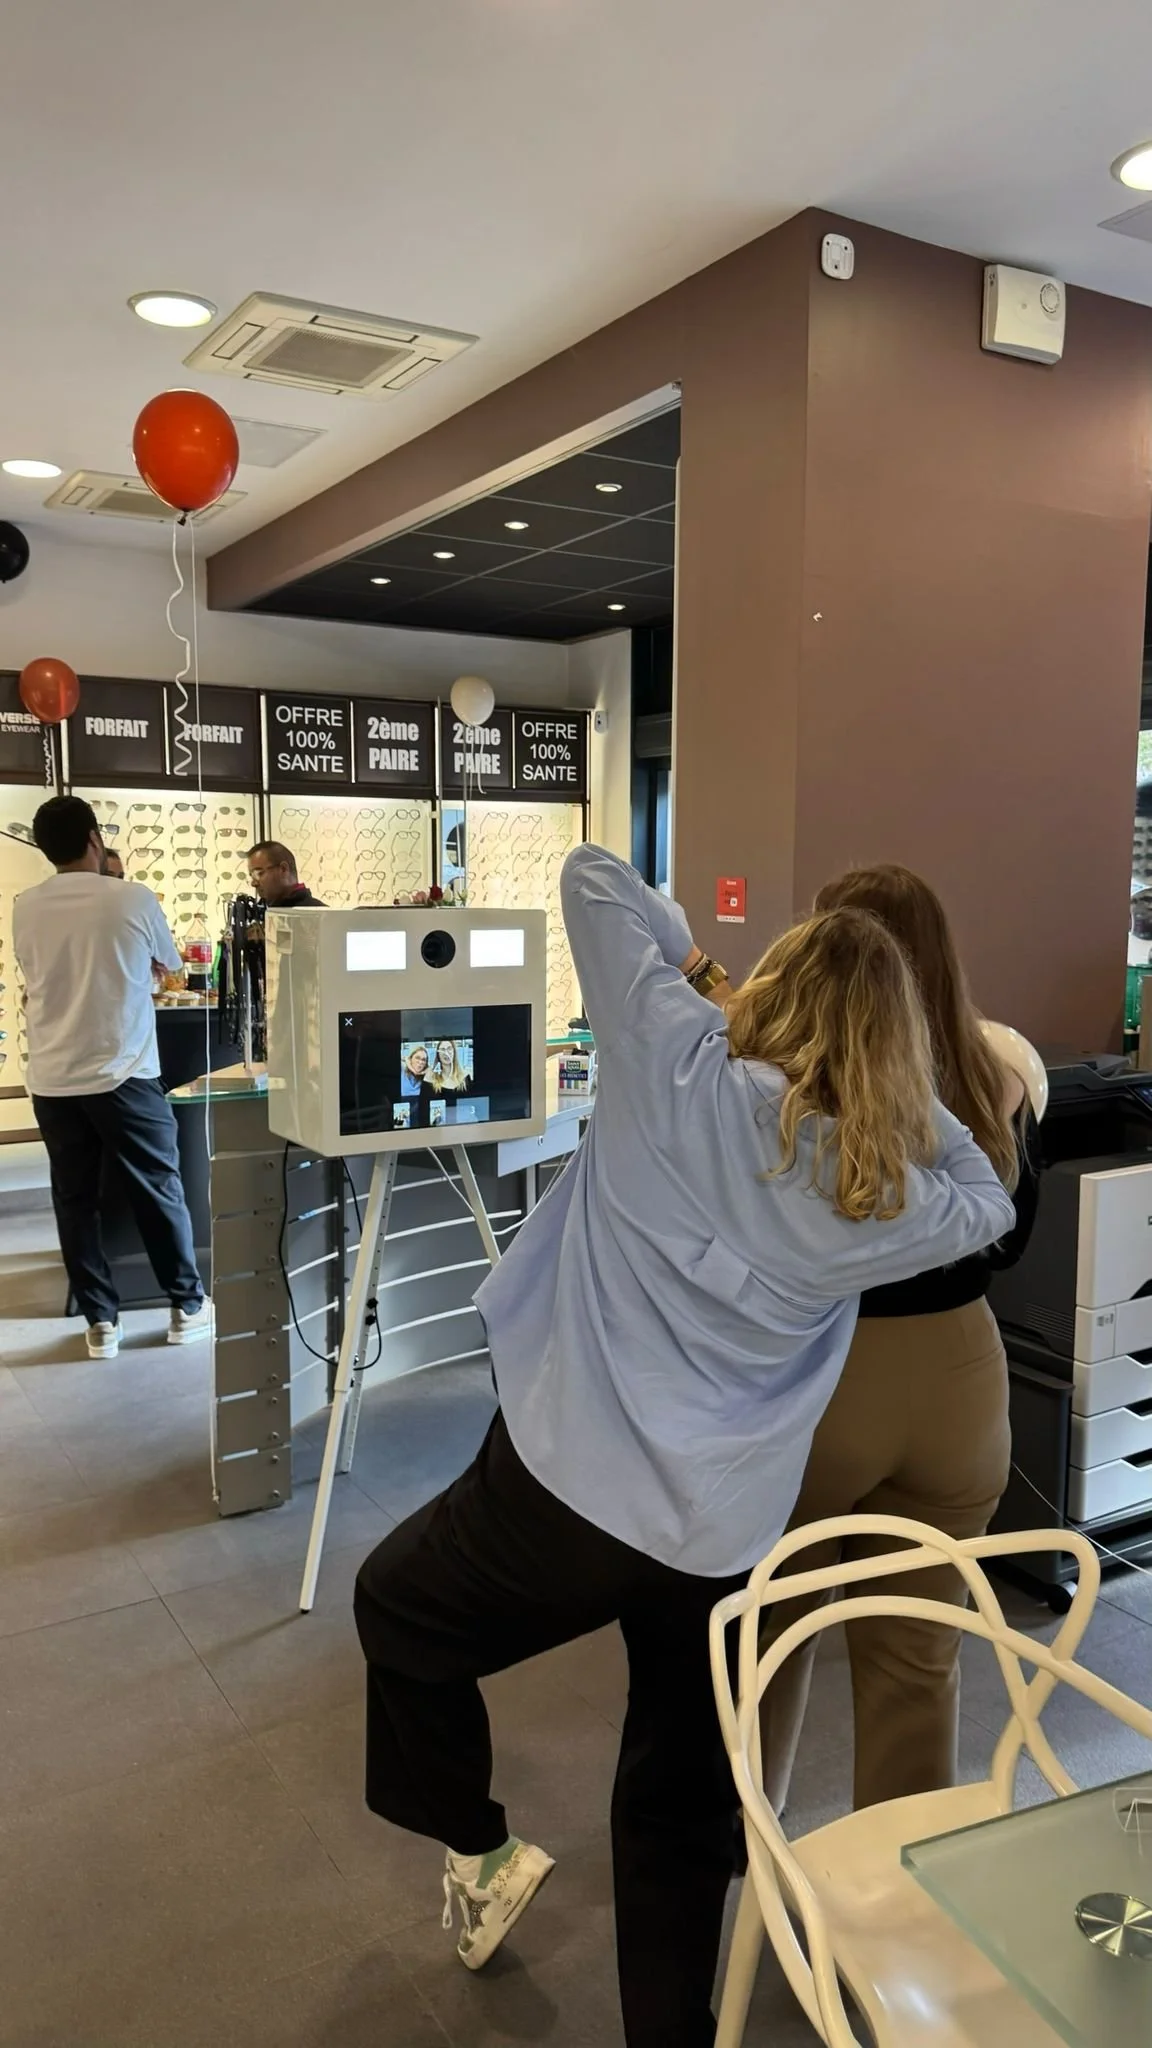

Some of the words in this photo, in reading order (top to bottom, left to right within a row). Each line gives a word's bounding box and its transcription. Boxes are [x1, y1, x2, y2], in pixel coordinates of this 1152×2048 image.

[275, 705, 344, 727] OFFRE
[1, 724, 41, 733] EYEWEAR
[85, 716, 149, 739] FORFAIT
[183, 723, 244, 744] FORFAIT
[367, 716, 420, 742] 2ème
[521, 721, 578, 740] OFFRE
[286, 729, 336, 750] 100%
[277, 752, 345, 773] SANTE
[368, 747, 420, 771] PAIRE
[530, 743, 571, 761] 100%
[453, 751, 501, 775] PAIRE
[522, 763, 578, 782] SANTE
